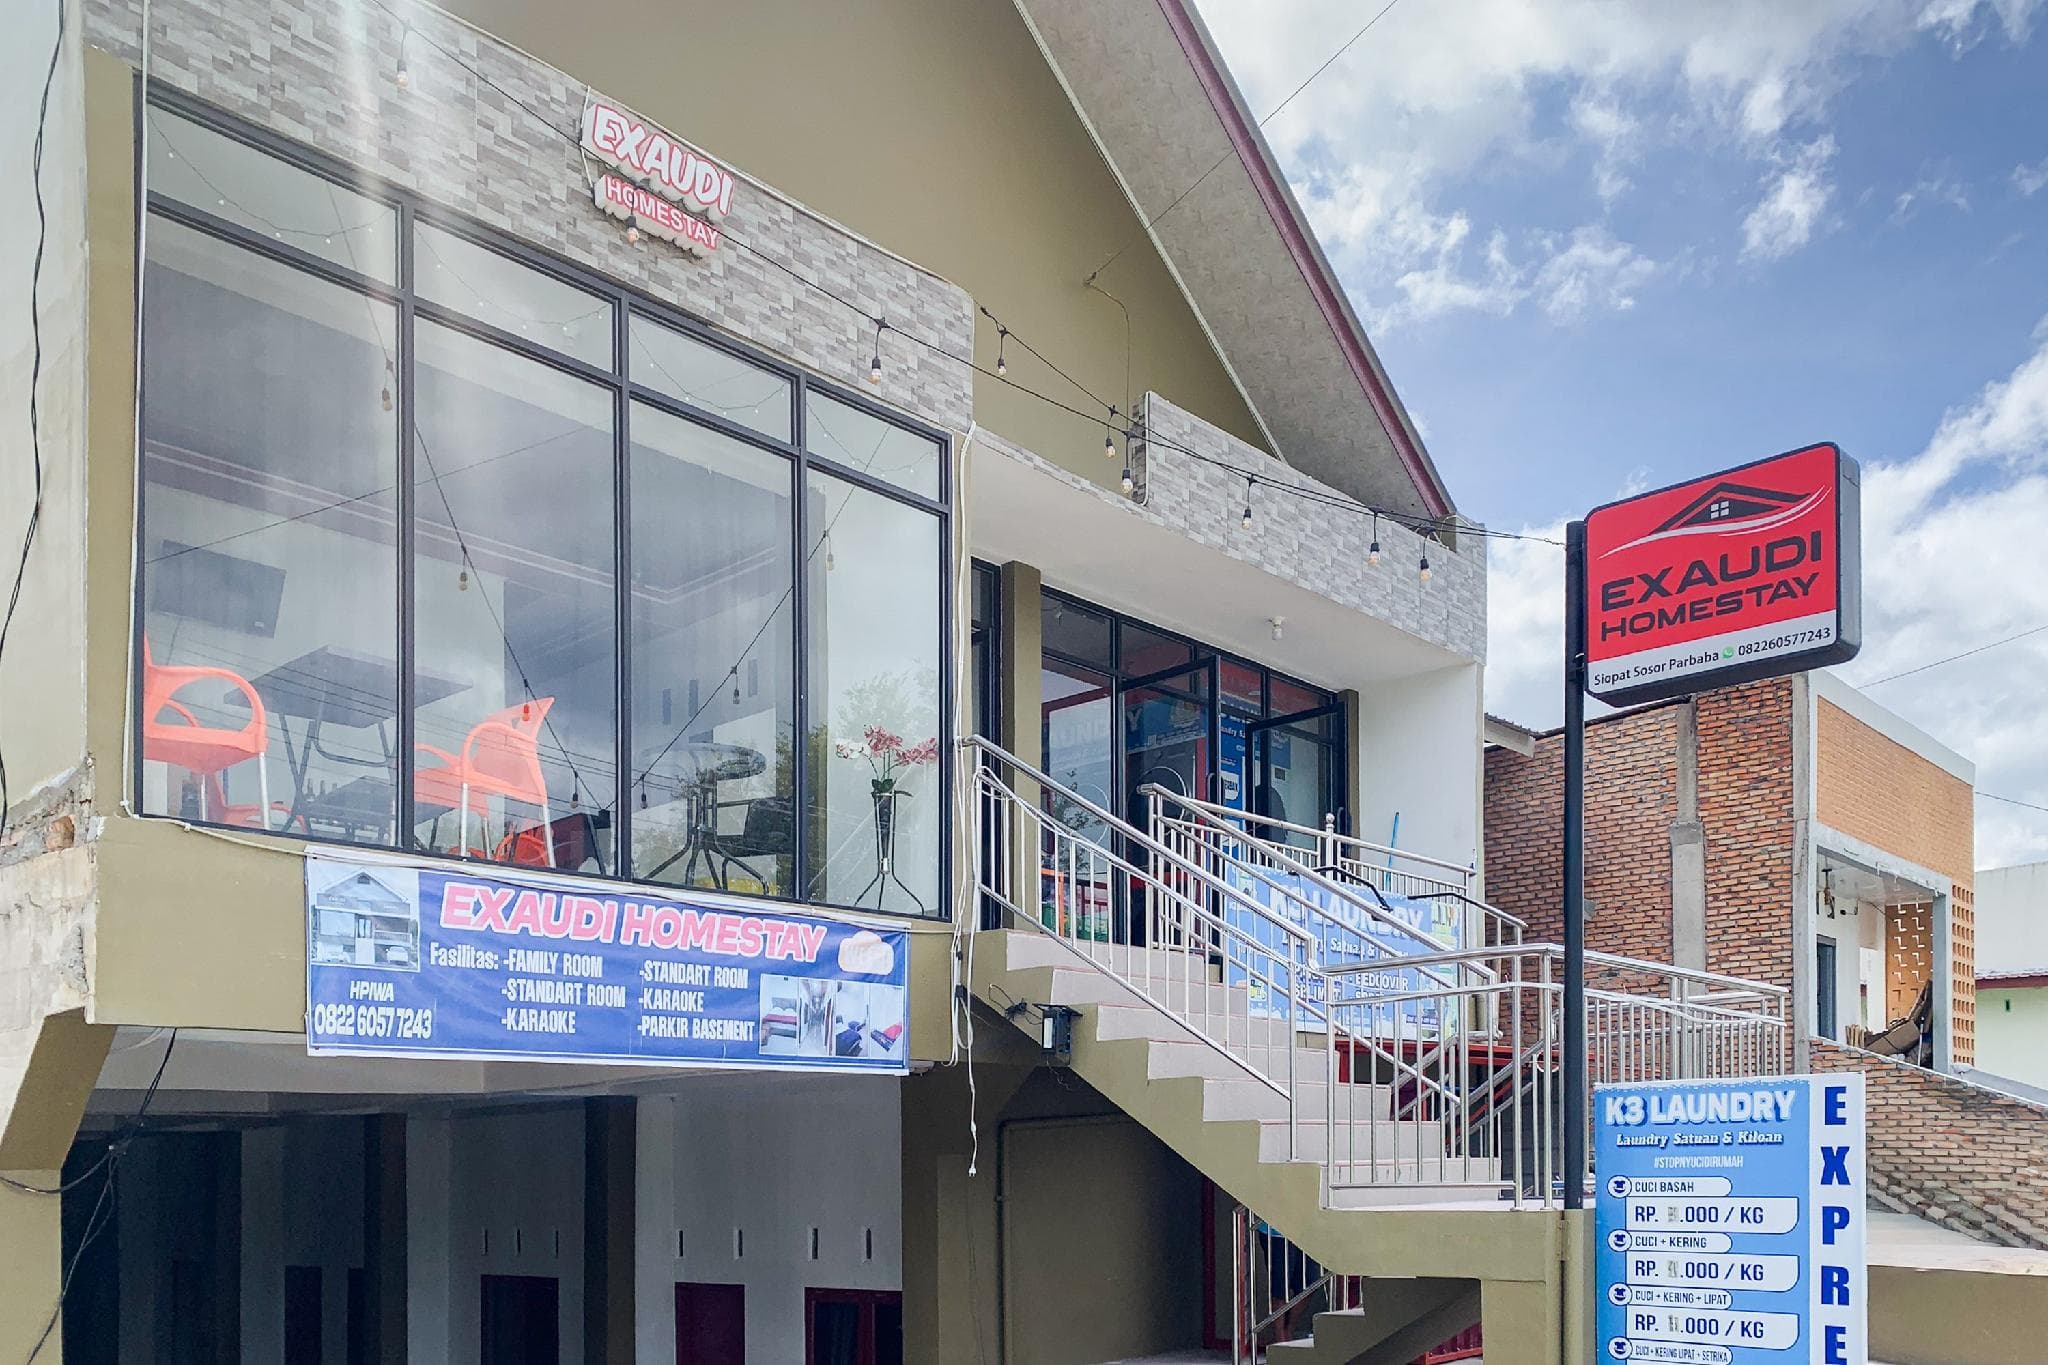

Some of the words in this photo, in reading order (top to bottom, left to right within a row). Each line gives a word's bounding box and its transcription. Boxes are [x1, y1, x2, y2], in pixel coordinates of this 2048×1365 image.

[593, 104, 733, 215] EXAUDI
[604, 175, 720, 250] HOMESTAY
[1602, 530, 1822, 612] EXAUDI
[1601, 572, 1820, 641] HOMESTAY
[1633, 662, 1667, 678] Sosor
[1669, 650, 1719, 670] Parbaba
[1738, 627, 1831, 657] 082260577243
[440, 882, 618, 943] EXAUDI
[620, 902, 827, 963] HOMESTAY
[430, 941, 499, 970] Fasilitas:
[503, 948, 559, 976] -FAMILY
[563, 952, 603, 978] ROOM
[639, 959, 711, 987] -STANDART
[713, 965, 749, 990] ROOM
[501, 977, 583, 1005] -STANDART
[587, 982, 626, 1008] ROOM
[638, 987, 704, 1013] -KARAOKE
[314, 1003, 355, 1036] 0822
[501, 1006, 576, 1034] -KARAOKE
[692, 1017, 755, 1042] BASEMENT
[1605, 1095, 1648, 1127] K3
[1650, 1090, 1796, 1125] LAUNDRY
[1616, 1133, 1668, 1149] Laundry
[1673, 1132, 1719, 1146] Satuan
[1722, 1131, 1733, 1145] &
[1738, 1130, 1784, 1145] Kiloan
[1653, 1155, 1744, 1169] #STOPNYUCIDIRUMAH
[1635, 1181, 1657, 1193] CUCI
[1660, 1181, 1694, 1193] BASAH
[1635, 1205, 1659, 1223] RP.
[1667, 1206, 1719, 1223] .000
[1724, 1206, 1735, 1223] /
[1740, 1207, 1764, 1224] KG
[1635, 1235, 1657, 1247] CUCI
[1669, 1236, 1707, 1249] KERING
[1635, 1260, 1659, 1277] RP.
[1667, 1260, 1719, 1279] .000
[1724, 1263, 1735, 1280] /
[1740, 1264, 1764, 1281] KG
[1635, 1290, 1654, 1302] CUCI
[1663, 1291, 1695, 1304] KERING
[1704, 1294, 1728, 1306] LIPAT
[1635, 1314, 1659, 1332] RP.
[1667, 1314, 1719, 1336] .000
[1724, 1320, 1735, 1337] /
[1740, 1320, 1764, 1339] KG
[1702, 1350, 1728, 1363] SETRIKA
